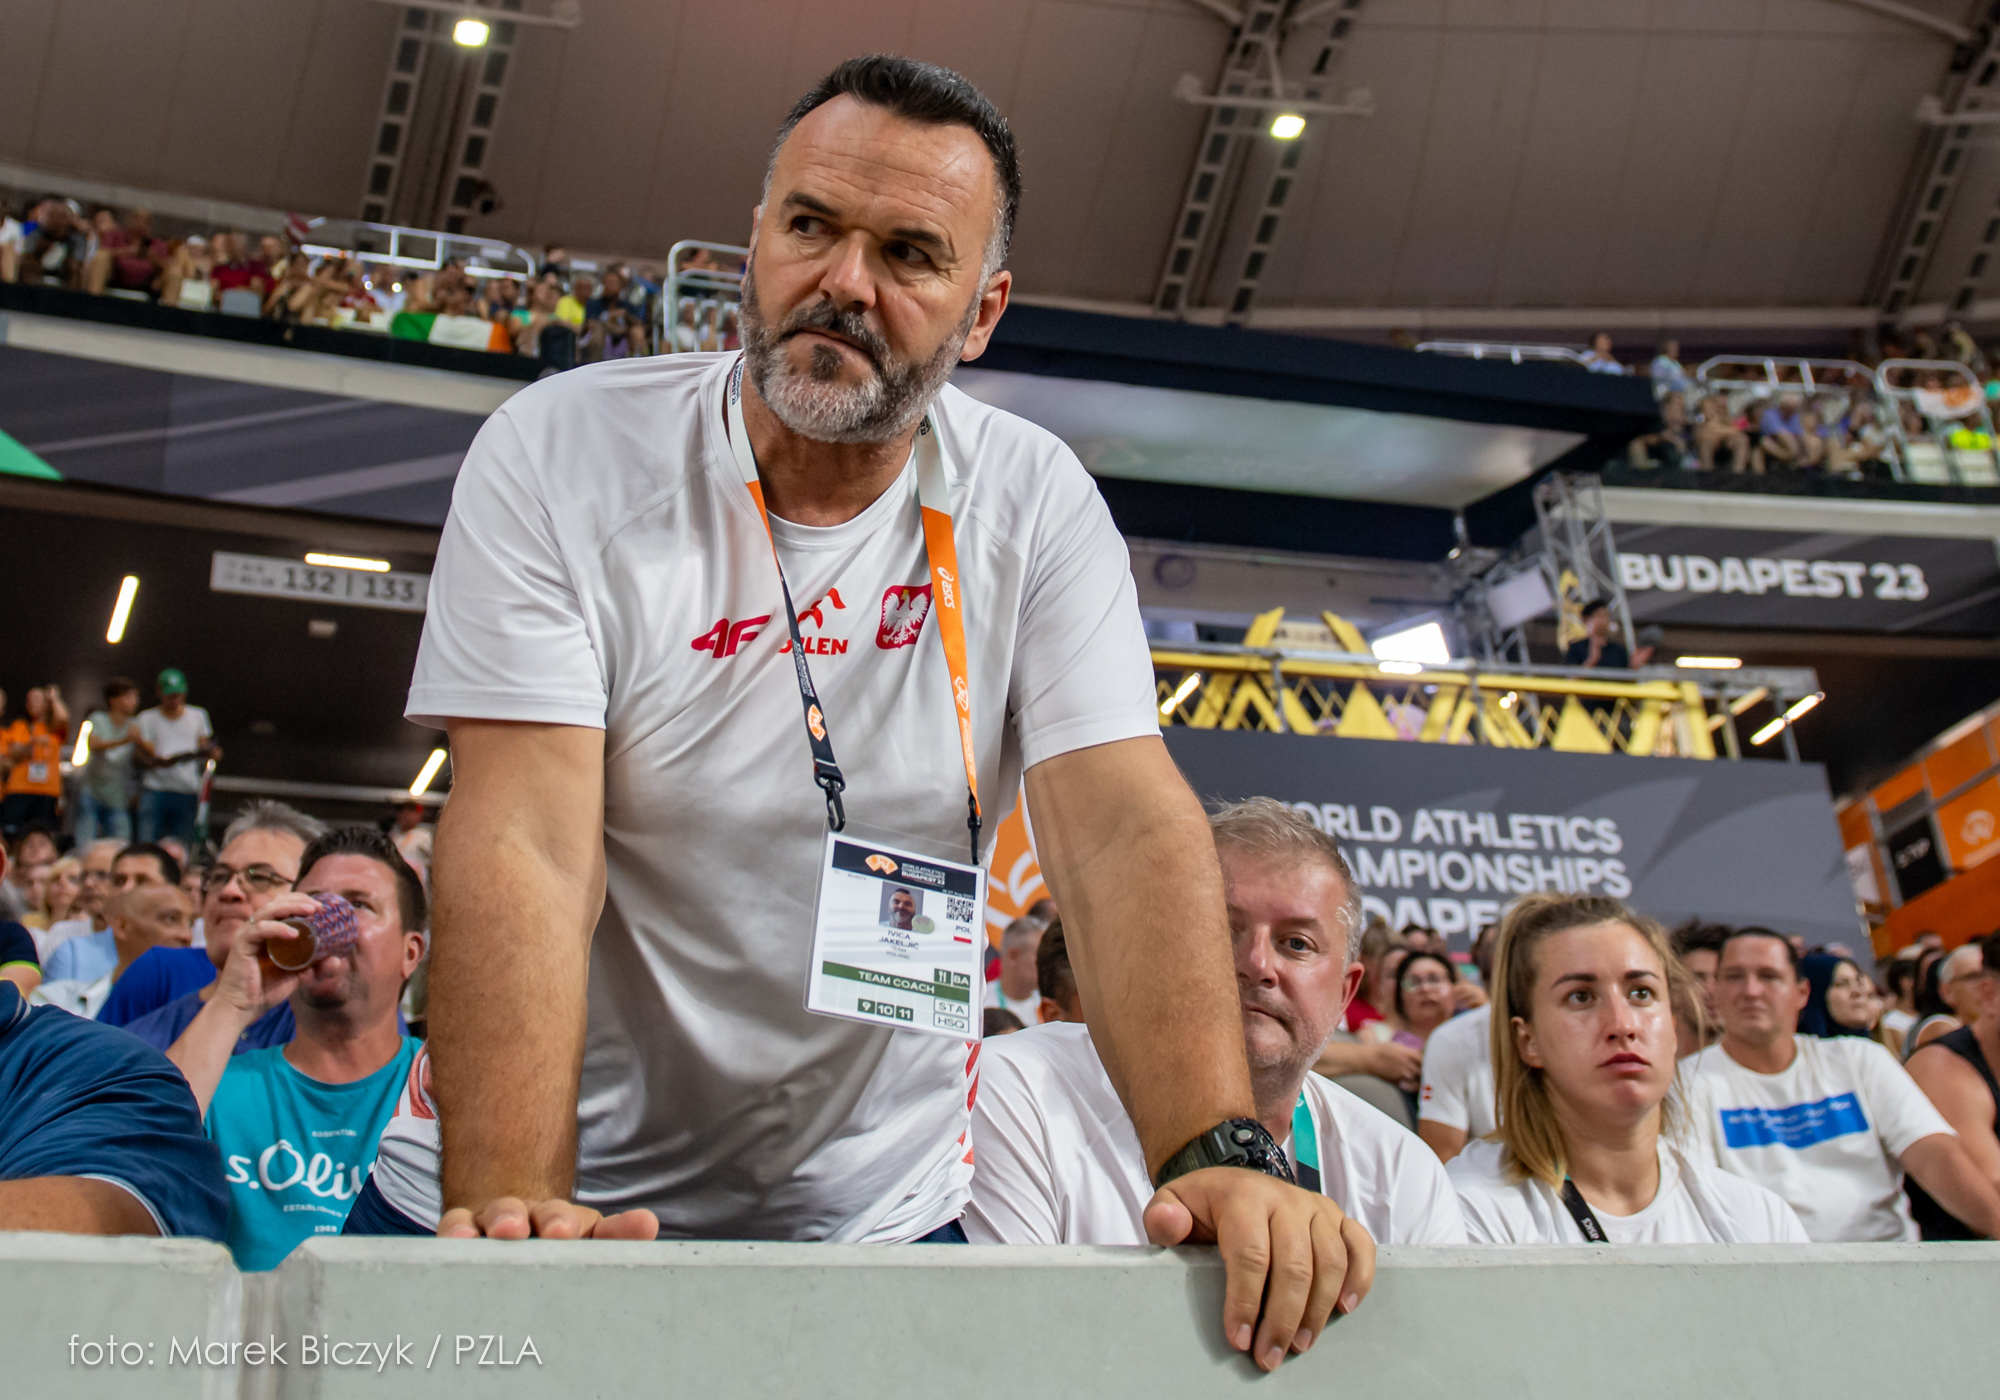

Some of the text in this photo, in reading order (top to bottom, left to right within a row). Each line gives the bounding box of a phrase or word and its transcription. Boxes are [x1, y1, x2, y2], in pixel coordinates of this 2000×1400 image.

[284, 567, 336, 595] 132
[364, 575, 415, 602] 133
[1617, 552, 1930, 602] BUDAPEST 23
[778, 636, 849, 656] LEN
[1282, 801, 1623, 855] ORLD ATHLETICS
[1337, 845, 1633, 899] MPIONSHIPS
[887, 929, 911, 940] IVICA
[955, 925, 972, 934] POL
[858, 970, 936, 995] TEAM COACH
[953, 972, 970, 986] BA
[861, 1001, 912, 1019] 9 10 11
[938, 1002, 965, 1015] STA
[937, 1016, 965, 1029] HSQ
